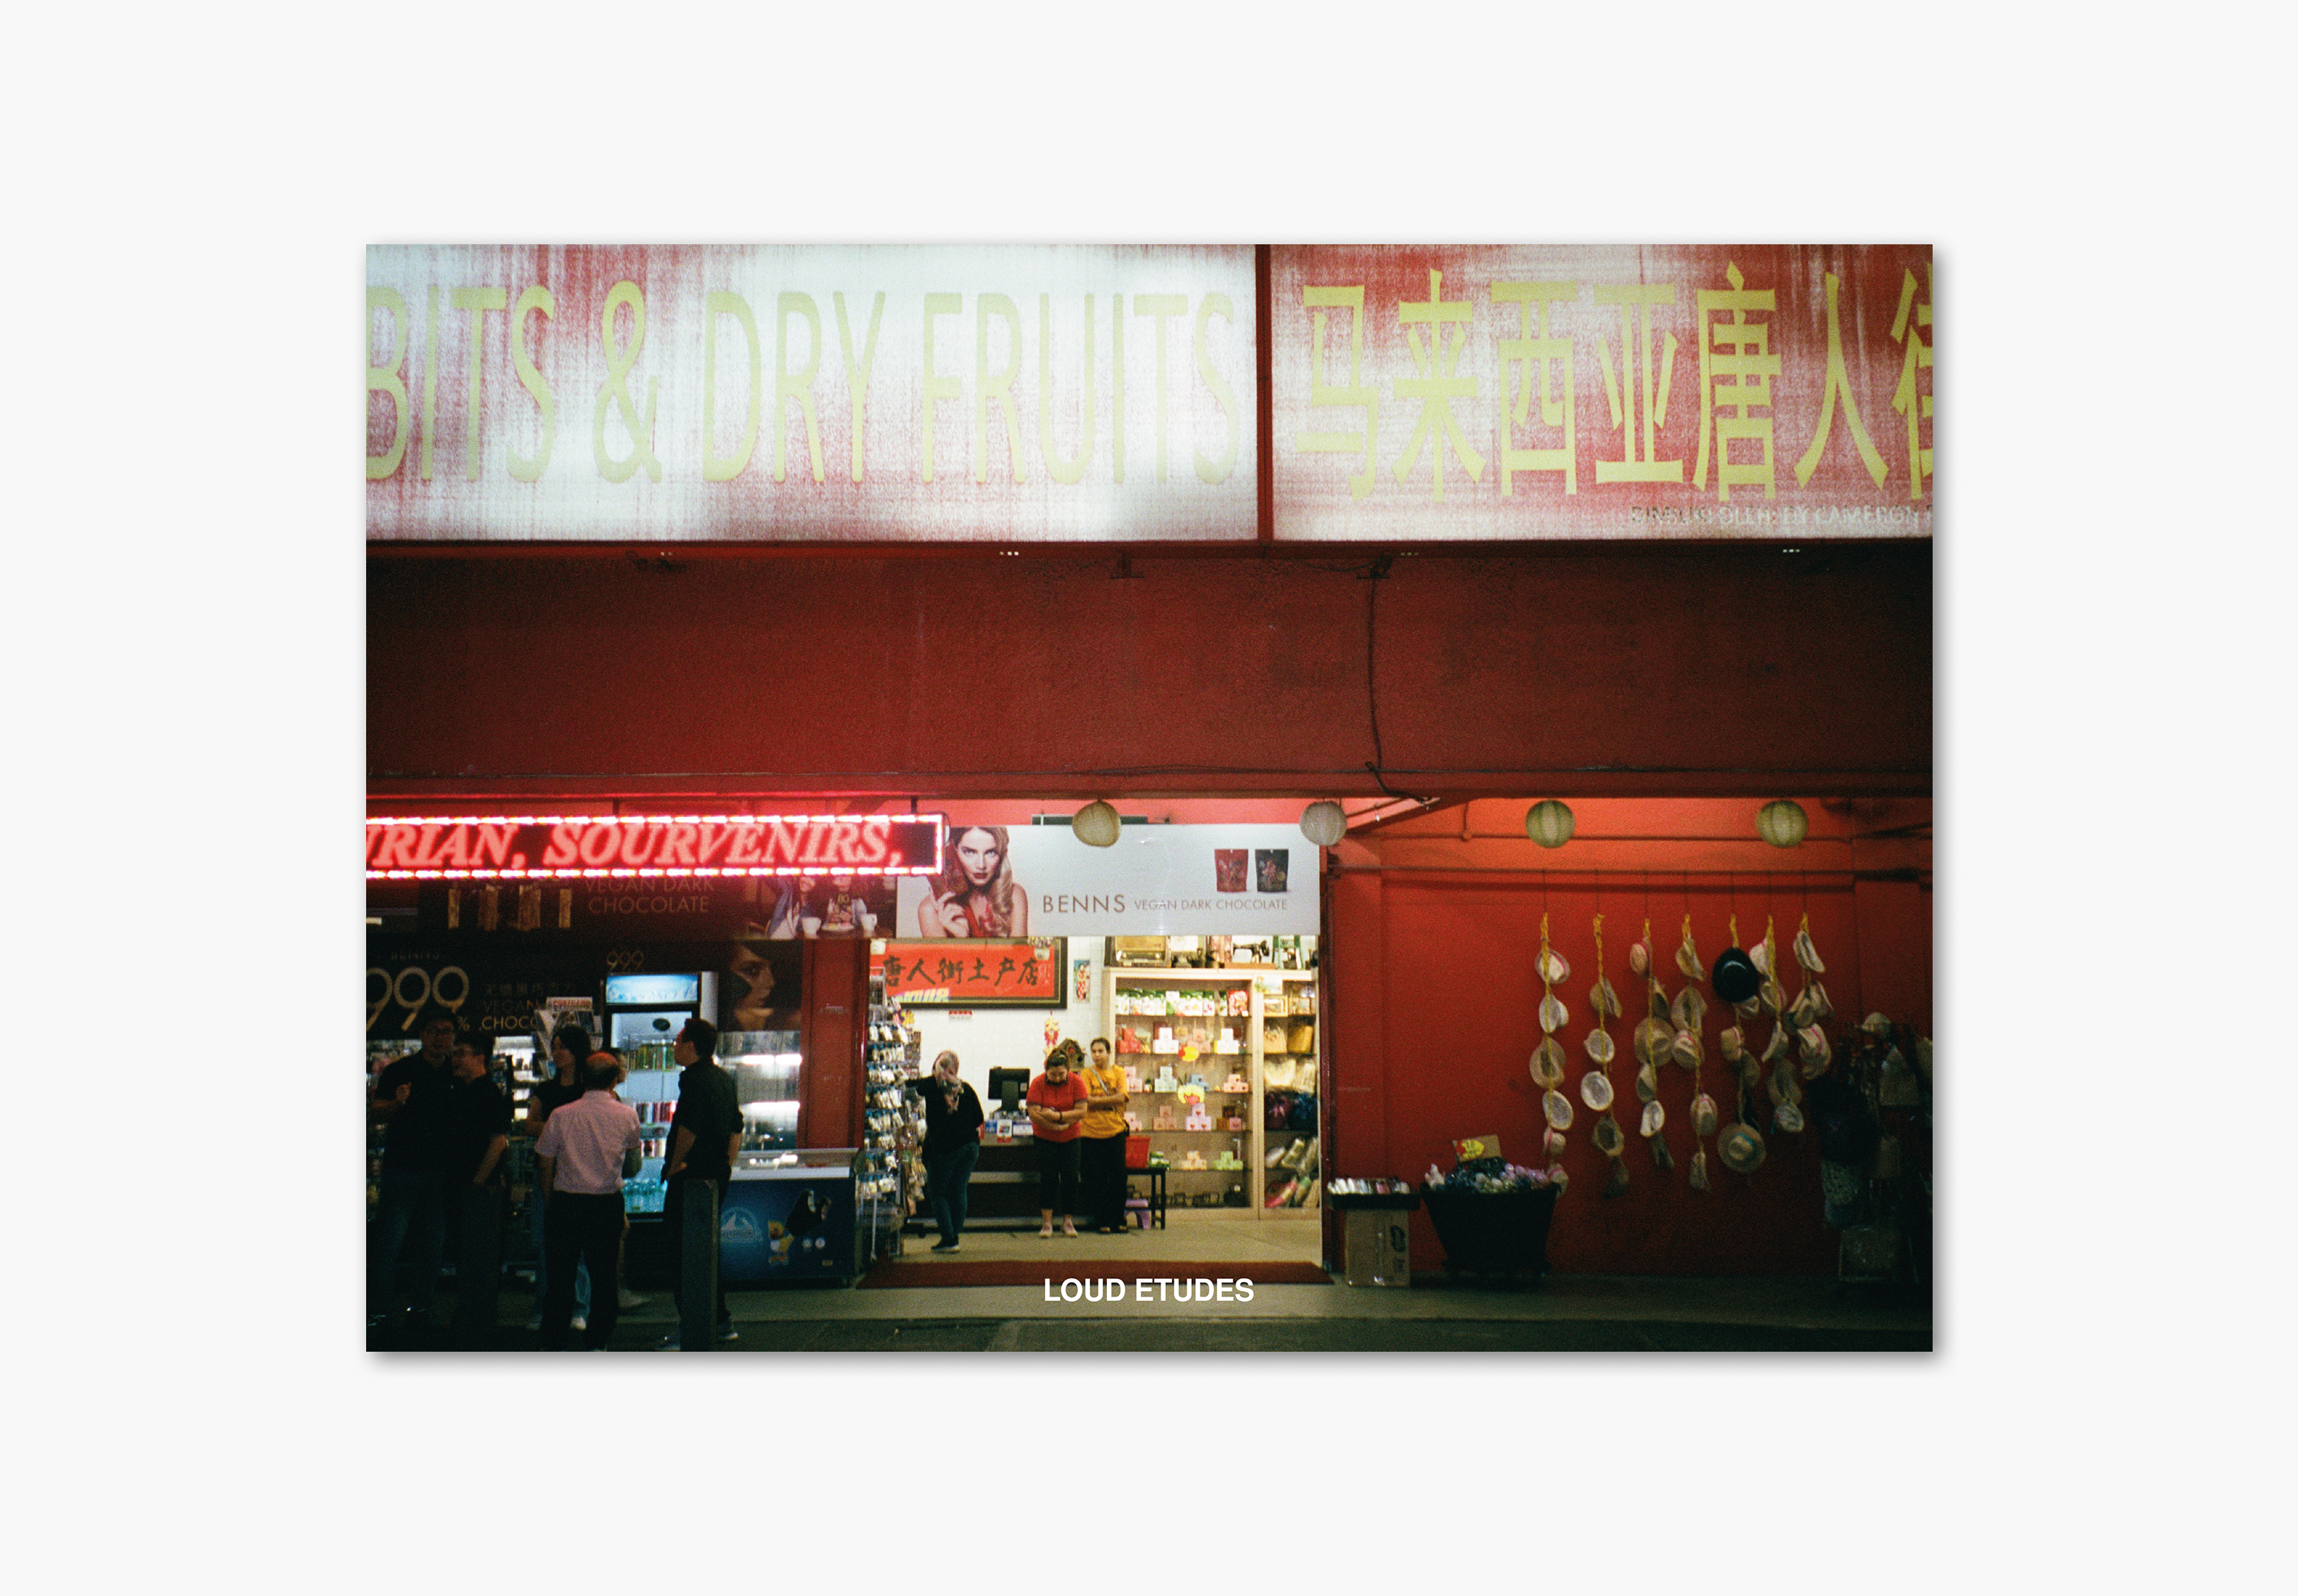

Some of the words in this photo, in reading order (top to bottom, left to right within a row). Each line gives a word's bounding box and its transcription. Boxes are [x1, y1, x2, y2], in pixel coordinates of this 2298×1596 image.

[366, 284, 555, 482] BITS
[592, 280, 663, 484] &
[701, 290, 886, 483] DRY
[921, 291, 1240, 485] FRUITS
[542, 821, 903, 868] SOURVENIRS,
[588, 895, 709, 914] CHOCOLATE
[1043, 894, 1125, 914] BENNS
[1134, 898, 1177, 911] VEGAN
[1181, 898, 1211, 911] DARK
[1216, 898, 1288, 910] CHOCOLATE
